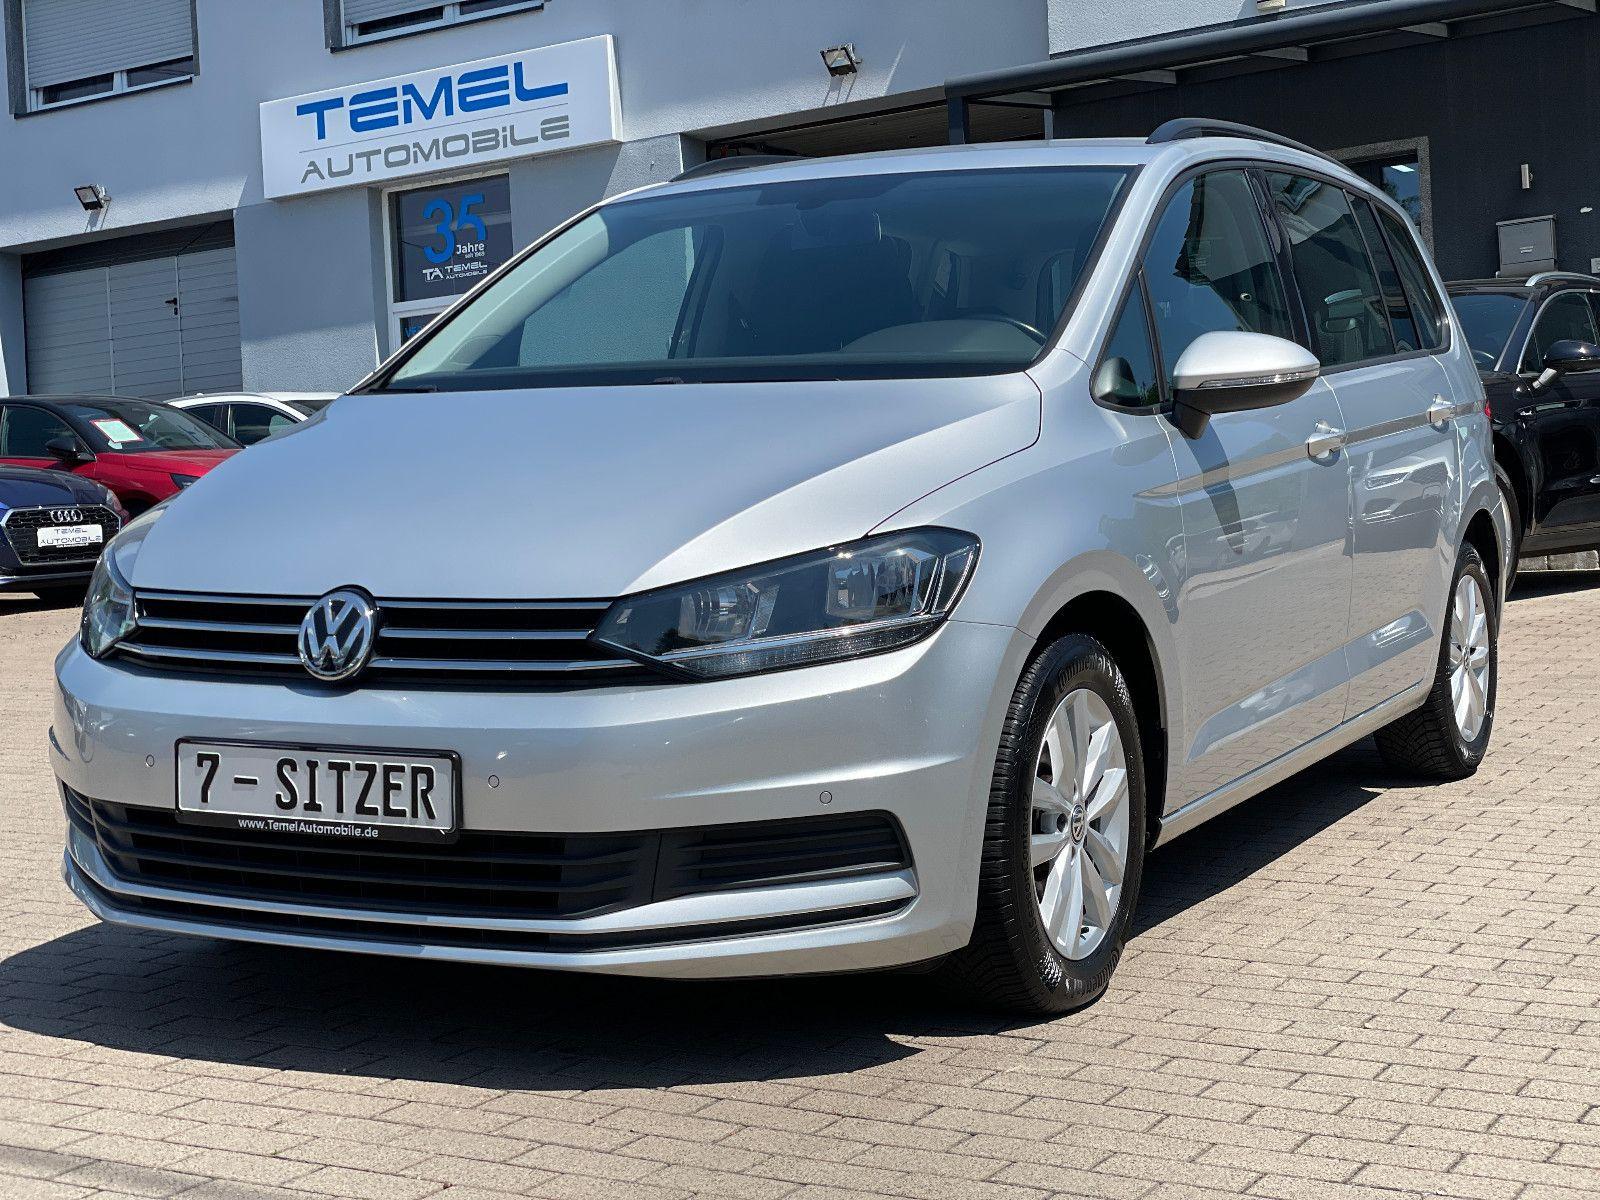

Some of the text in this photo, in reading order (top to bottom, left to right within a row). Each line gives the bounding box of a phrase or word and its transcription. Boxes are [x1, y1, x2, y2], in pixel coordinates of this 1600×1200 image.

[296, 61, 569, 140] TEMEL
[423, 193, 486, 263] 35
[456, 242, 485, 255] Jahre
[444, 261, 488, 273] TEMEL
[196, 752, 220, 803] 7
[275, 757, 436, 820] SITZER
[238, 818, 380, 838] www.TemelAutomobile.de
